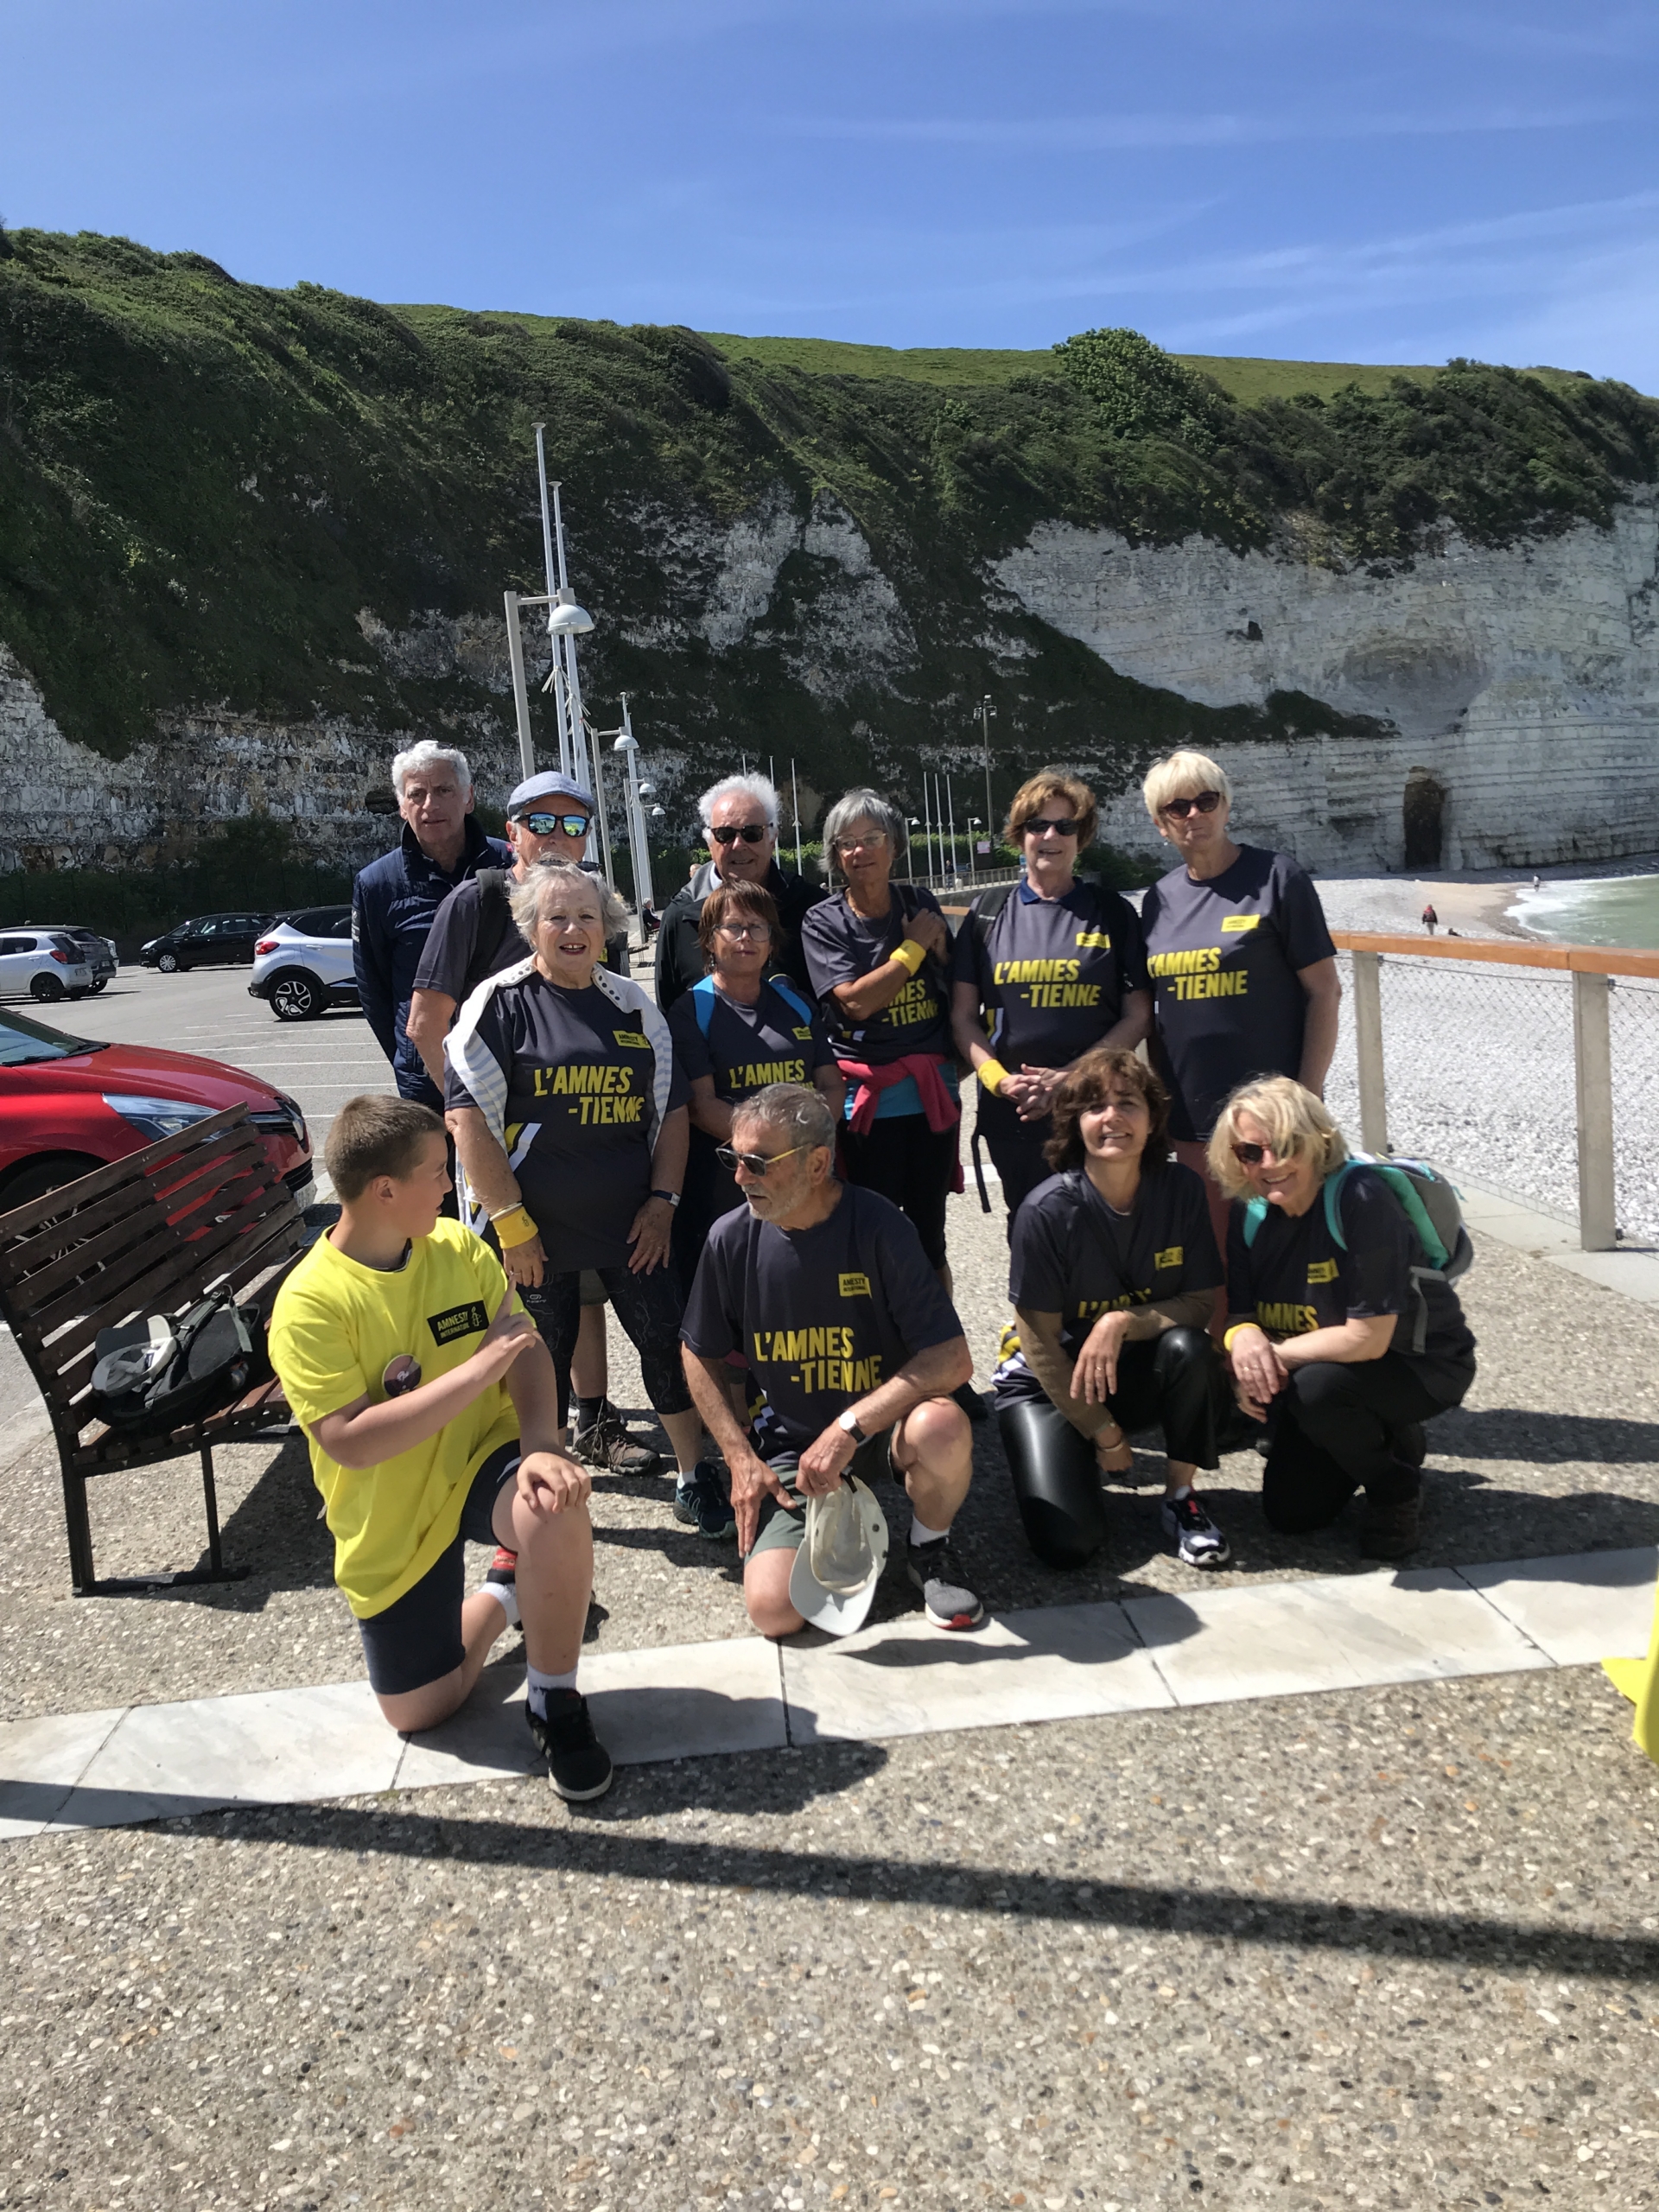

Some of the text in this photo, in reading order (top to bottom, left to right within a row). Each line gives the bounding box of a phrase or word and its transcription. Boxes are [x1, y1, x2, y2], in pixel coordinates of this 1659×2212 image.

[994, 959, 1081, 985] L'AMNES
[1166, 970, 1249, 1001] -TIENNE
[534, 1065, 633, 1096] L'AMNES
[729, 1059, 805, 1089] L'AMNES
[753, 1326, 855, 1362] L'AMNES
[791, 1355, 882, 1394] -TIENNE
